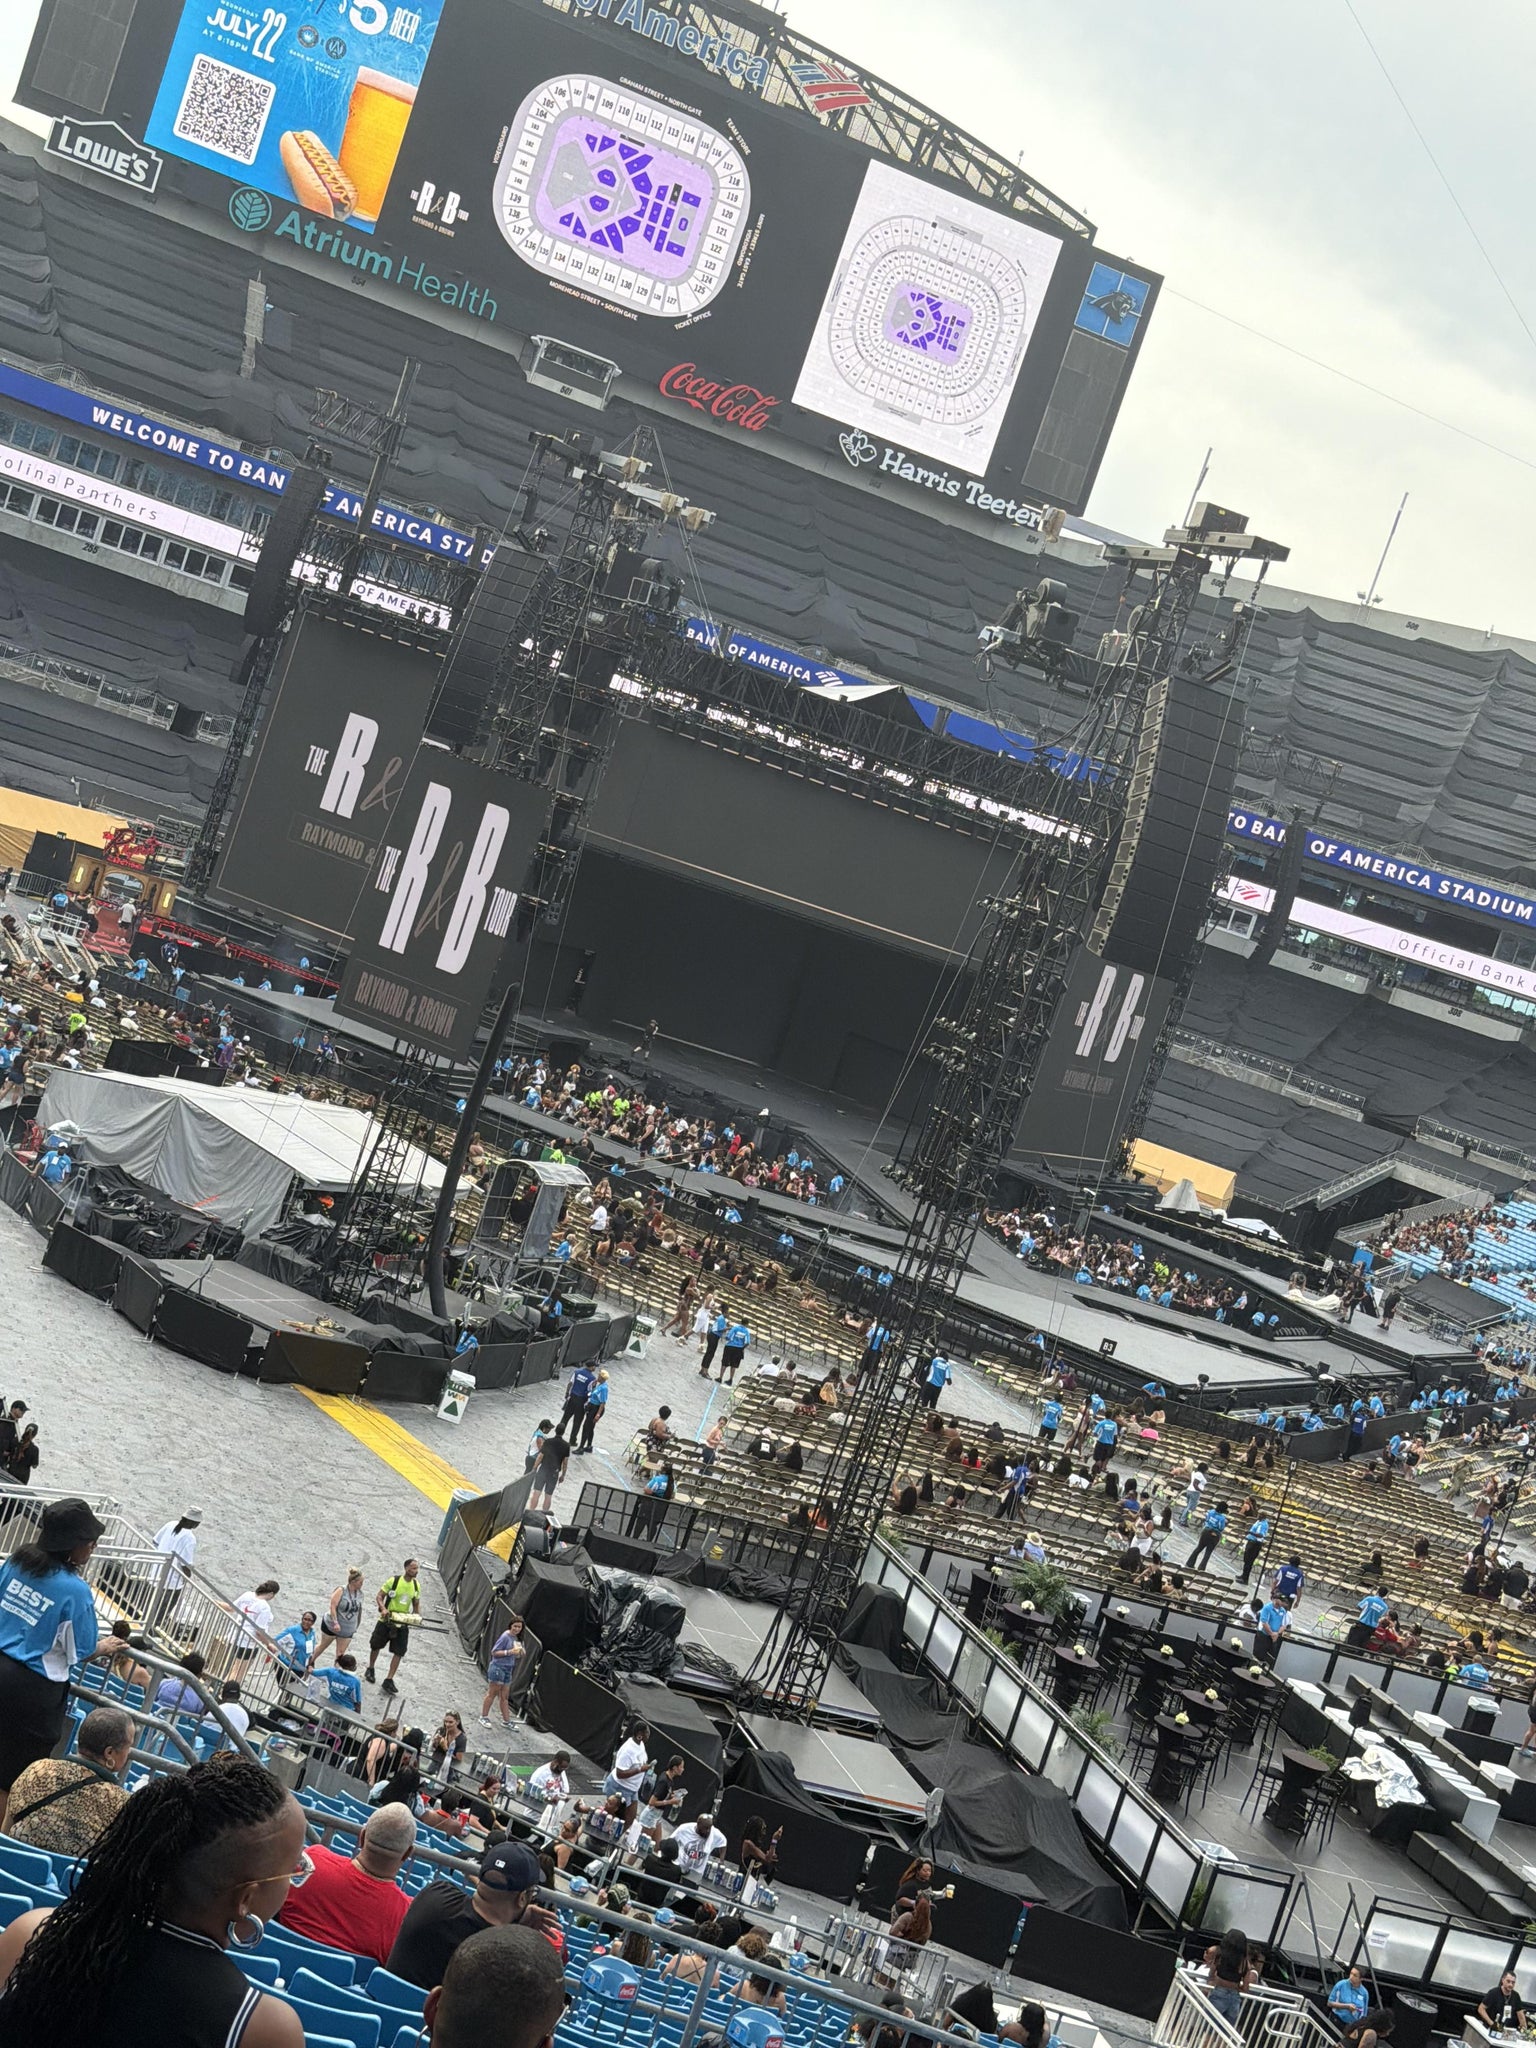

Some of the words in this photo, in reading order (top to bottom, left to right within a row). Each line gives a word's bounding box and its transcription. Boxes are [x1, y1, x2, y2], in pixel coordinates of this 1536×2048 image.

[388, 6, 421, 44] BEER
[202, 28, 215, 38] AT
[206, 7, 260, 41] JULY
[251, 7, 287, 64] 22
[616, 0, 770, 87] America
[554, 86, 567, 98] 106
[619, 76, 644, 92] GRAHAM
[644, 85, 665, 100] STREET
[668, 98, 688, 111] NORTH
[687, 106, 703, 117] GATE
[542, 97, 555, 109] 105
[601, 98, 614, 110] 109
[535, 107, 548, 119] 104
[618, 105, 631, 117] 110
[635, 112, 647, 124] 111
[650, 120, 663, 131] 112
[667, 126, 680, 138] 113
[726, 118, 740, 139] TEAM
[737, 135, 752, 156] STORE
[683, 133, 695, 144] 114
[58, 125, 149, 182] LOWE'S
[711, 148, 723, 158] 116
[723, 161, 734, 171] 117
[509, 192, 522, 204] 139
[726, 191, 739, 203] 119
[508, 208, 521, 219] 138
[721, 208, 734, 220] 120
[512, 225, 525, 236] 137
[715, 225, 728, 237] 121
[524, 239, 537, 251] 136
[749, 228, 761, 251] STREET
[539, 246, 549, 256] 135
[710, 243, 723, 254] 122
[554, 251, 567, 263] 134
[274, 210, 393, 280] Atrium
[396, 256, 498, 321] Health
[571, 259, 584, 270] 133
[704, 260, 717, 271] 123
[587, 265, 600, 277] 132
[603, 272, 616, 284] 131
[701, 273, 714, 285] 124
[620, 279, 633, 290] 130
[694, 283, 706, 295] 125
[636, 285, 649, 297] 129
[549, 280, 580, 298] MOREHEAD
[580, 292, 601, 306] STREET
[604, 303, 624, 316] SOUTH
[623, 309, 638, 320] GATE
[666, 296, 678, 306] 127
[674, 319, 693, 330] TICKET
[693, 310, 712, 323] OFFICE
[91, 405, 200, 459] WELCOME
[208, 448, 234, 471] TO
[237, 460, 287, 491] BAN
[879, 448, 961, 497] Harris
[966, 481, 1041, 528] Teeter
[63, 477, 157, 520] Panthers
[728, 643, 747, 657] OF
[747, 651, 811, 682] AMERICA
[303, 744, 331, 777] THE
[301, 821, 366, 862] RAYMOND
[1310, 840, 1338, 858] OF
[1338, 849, 1432, 890] AMERICA
[1437, 880, 1534, 920] STADIUM
[374, 846, 402, 893] THE
[483, 886, 518, 938] TOUR
[1398, 938, 1474, 972] Official
[1481, 965, 1526, 988] Bank
[355, 971, 410, 1020] RAYMOND
[413, 998, 458, 1038] BROWN
[1103, 1342, 1114, 1352] B3
[6, 1578, 55, 1612] BEST
